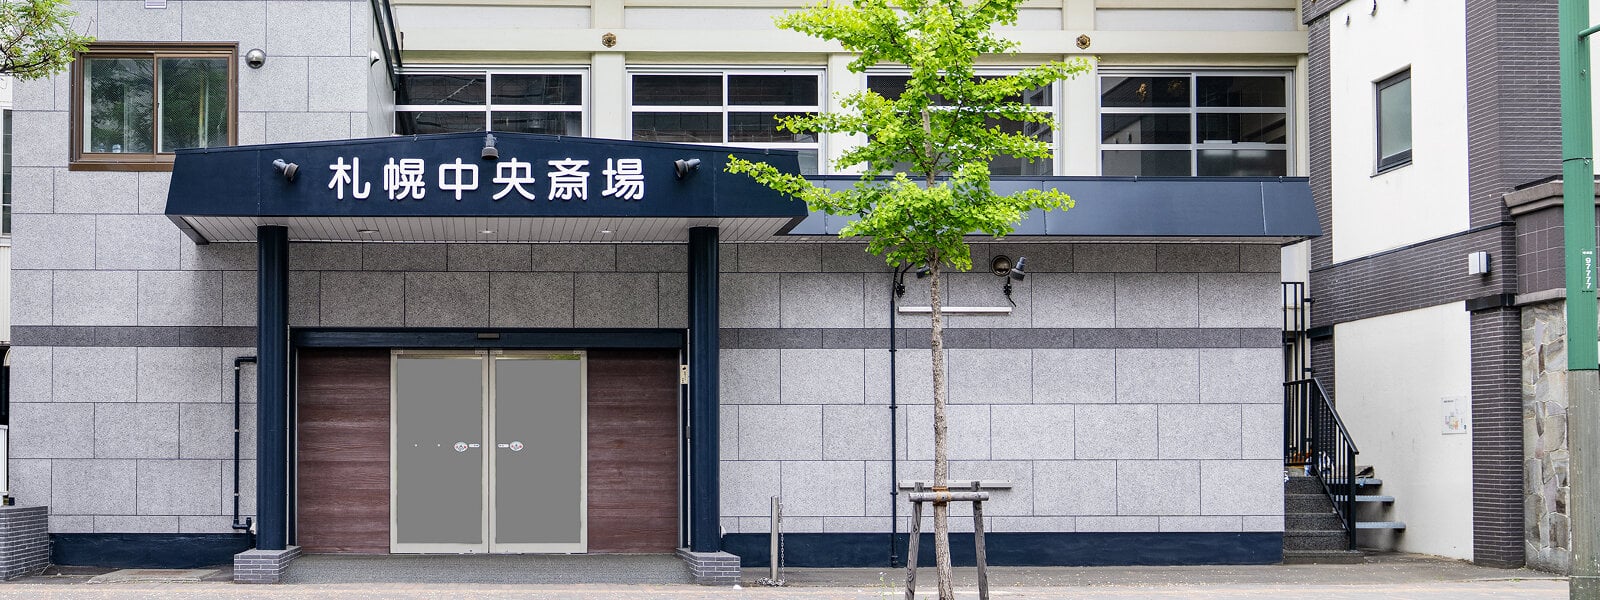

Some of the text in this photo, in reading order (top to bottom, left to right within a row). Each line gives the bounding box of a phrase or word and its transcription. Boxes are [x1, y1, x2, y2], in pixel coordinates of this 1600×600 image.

[328, 156, 645, 201] 札幌中央斎場
